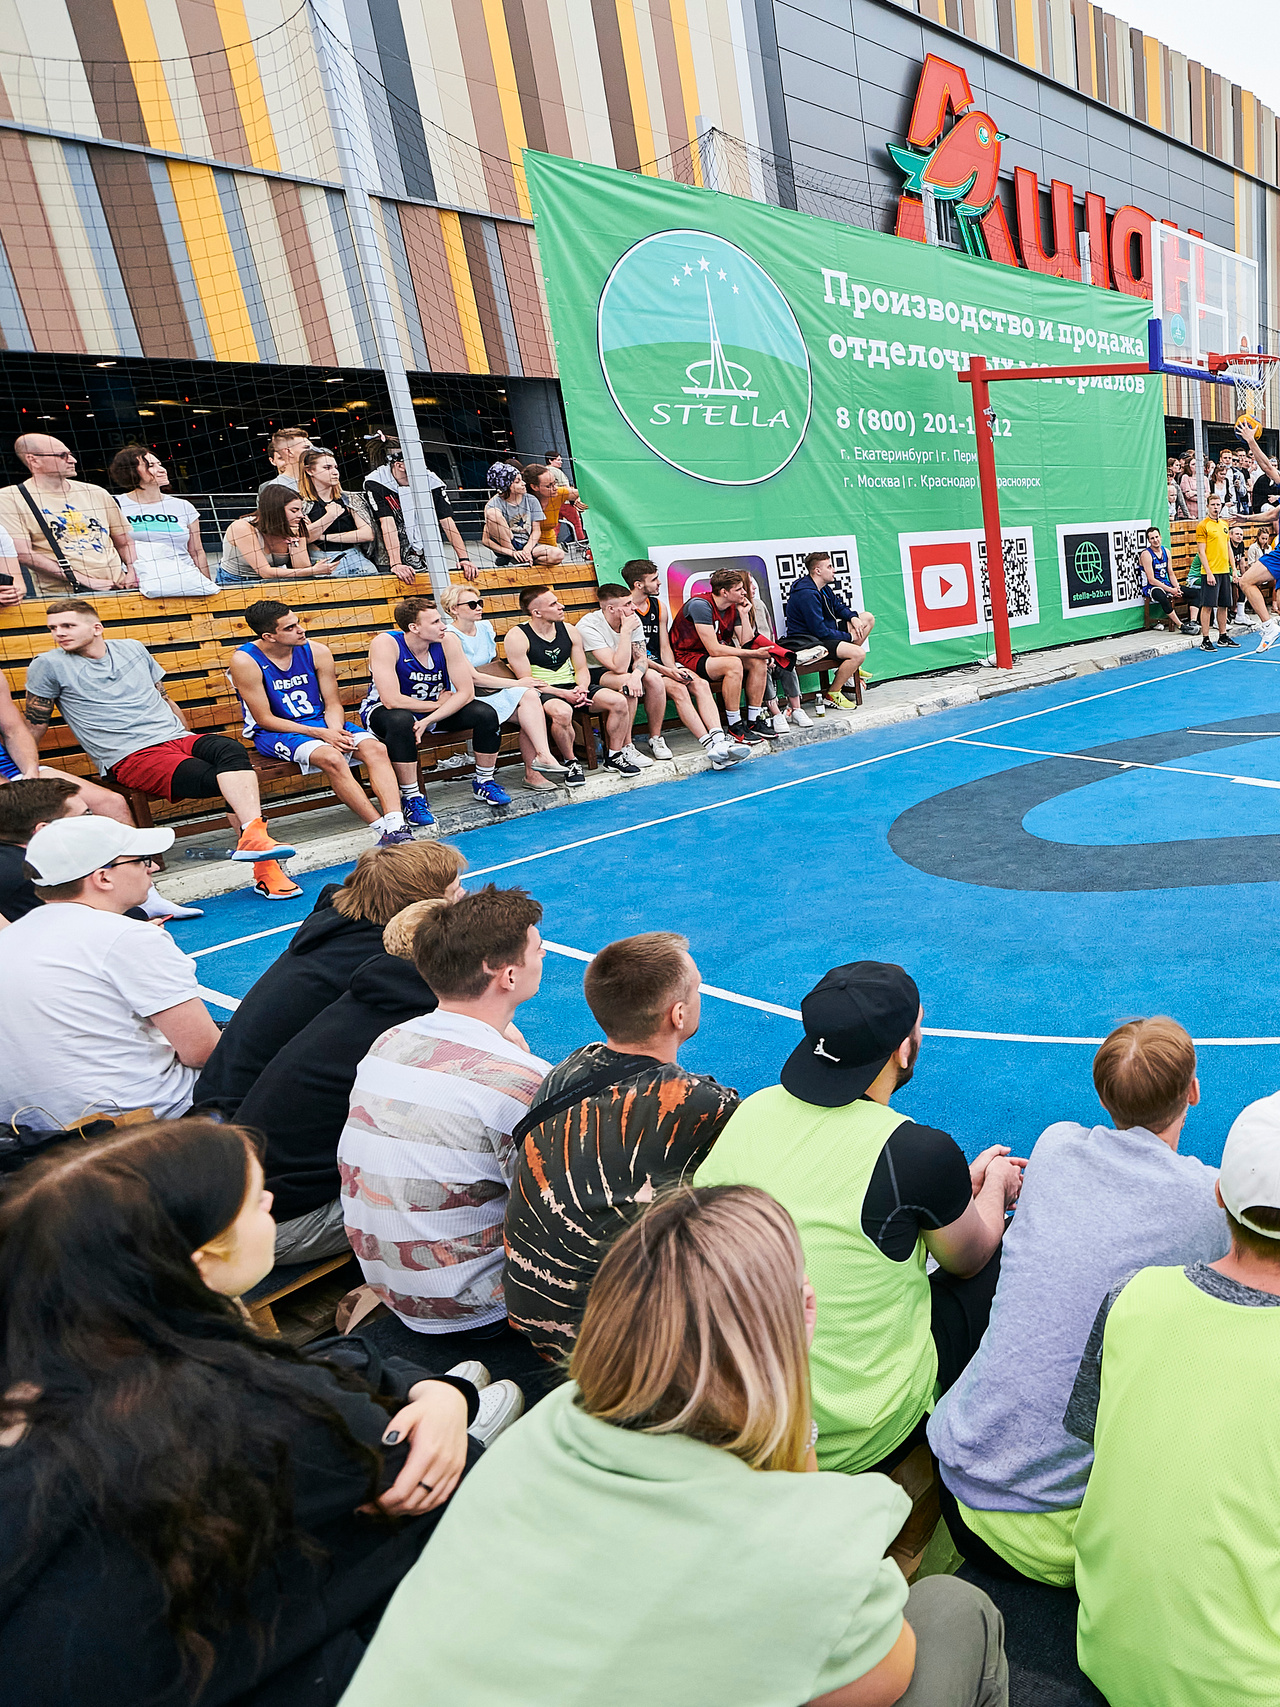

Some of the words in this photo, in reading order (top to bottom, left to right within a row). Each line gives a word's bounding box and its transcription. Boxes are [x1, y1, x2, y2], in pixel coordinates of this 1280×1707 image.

[894, 53, 1206, 318] Ашан
[820, 267, 1035, 339] Производство
[1038, 320, 1054, 342] и
[1058, 323, 1145, 357] продажа
[650, 402, 791, 429] STELLA
[836, 406, 850, 429] 8
[858, 407, 916, 436] (800)
[840, 448, 850, 460] г.
[953, 449, 978, 464] Перм
[843, 476, 854, 488] г.
[996, 476, 1041, 489] расноярск
[127, 513, 178, 524] MOOD
[1072, 588, 1112, 601] stella-b2b.ru
[281, 690, 315, 718] 13
